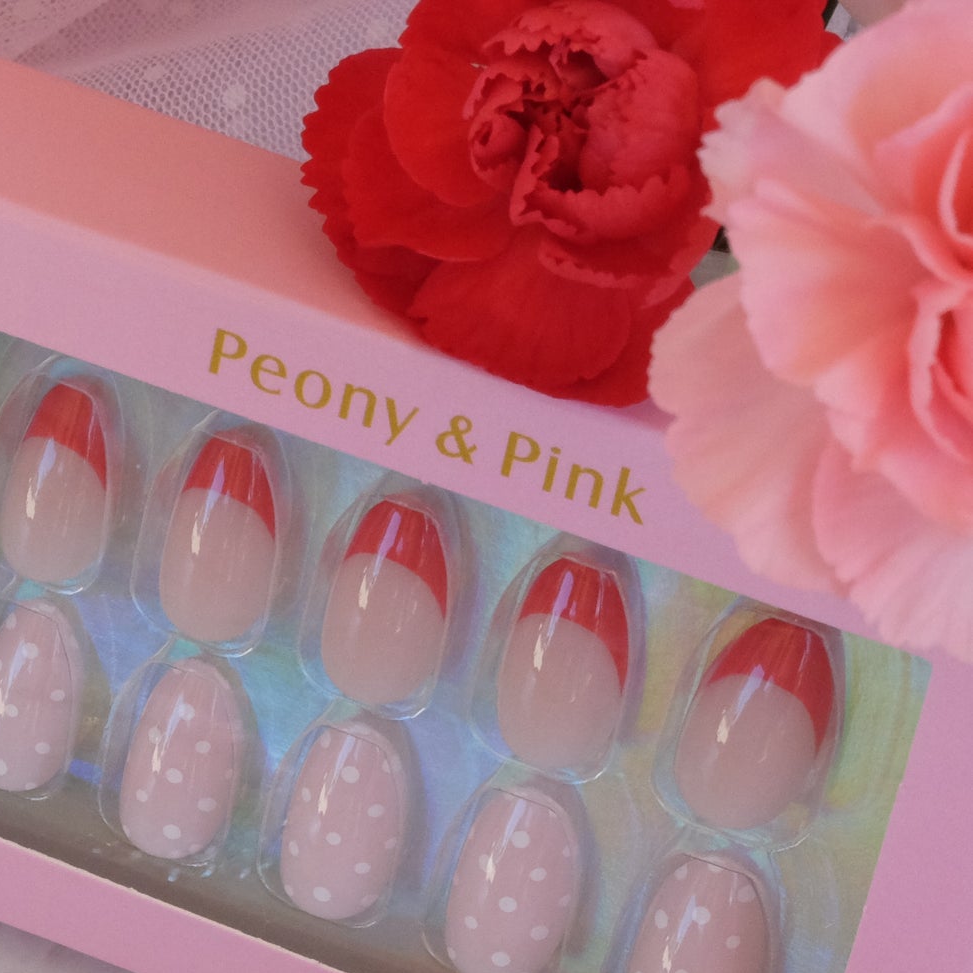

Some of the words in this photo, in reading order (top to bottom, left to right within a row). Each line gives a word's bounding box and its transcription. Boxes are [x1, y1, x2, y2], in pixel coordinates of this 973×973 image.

[208, 328, 420, 447] Peony
[435, 415, 479, 465] &
[500, 431, 647, 526] Pink
